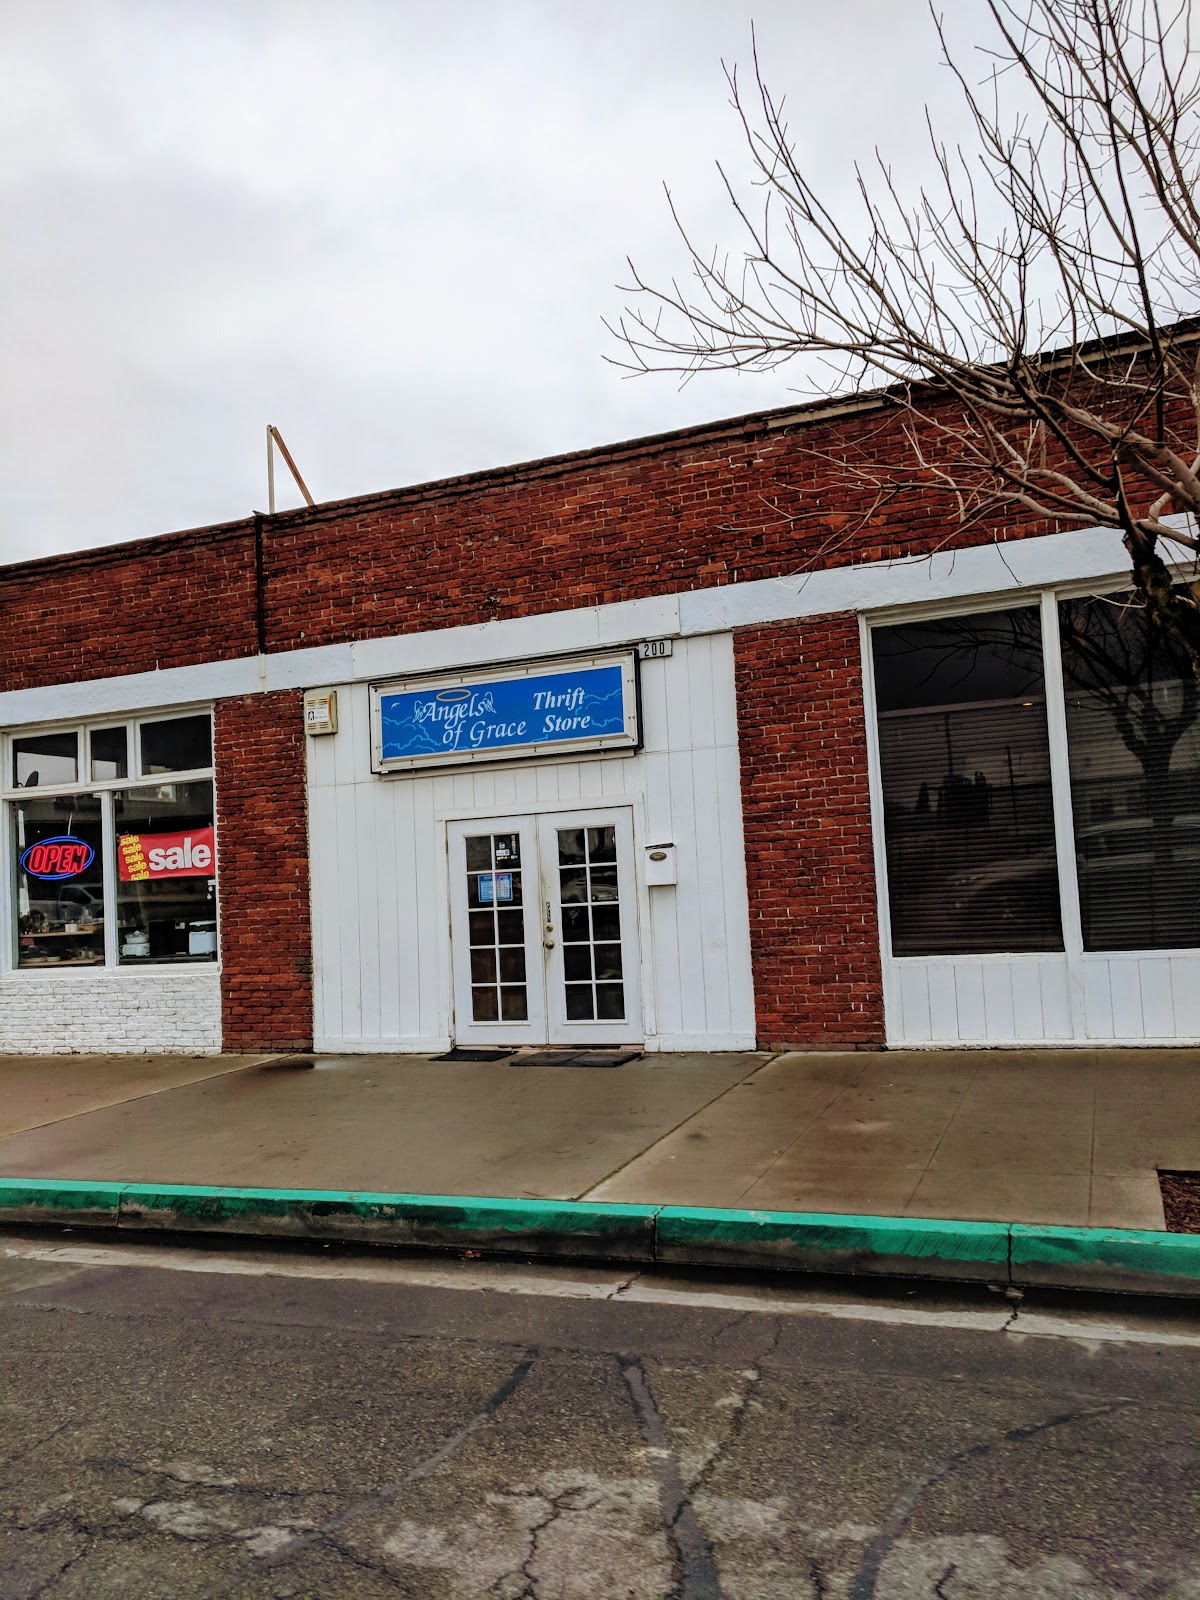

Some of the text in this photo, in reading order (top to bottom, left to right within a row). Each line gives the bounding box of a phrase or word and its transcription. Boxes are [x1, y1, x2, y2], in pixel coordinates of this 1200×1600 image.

[644, 641, 665, 657] 200
[533, 686, 586, 711] Thrift
[419, 693, 485, 730] Angels
[542, 714, 591, 733] Store
[442, 720, 527, 752] of Grace
[120, 834, 140, 846] sale
[122, 843, 142, 855] sale
[148, 837, 212, 872] sale
[28, 845, 87, 873] OPEN
[125, 852, 145, 864] sale
[128, 861, 147, 873] sale
[131, 870, 150, 881] sale
